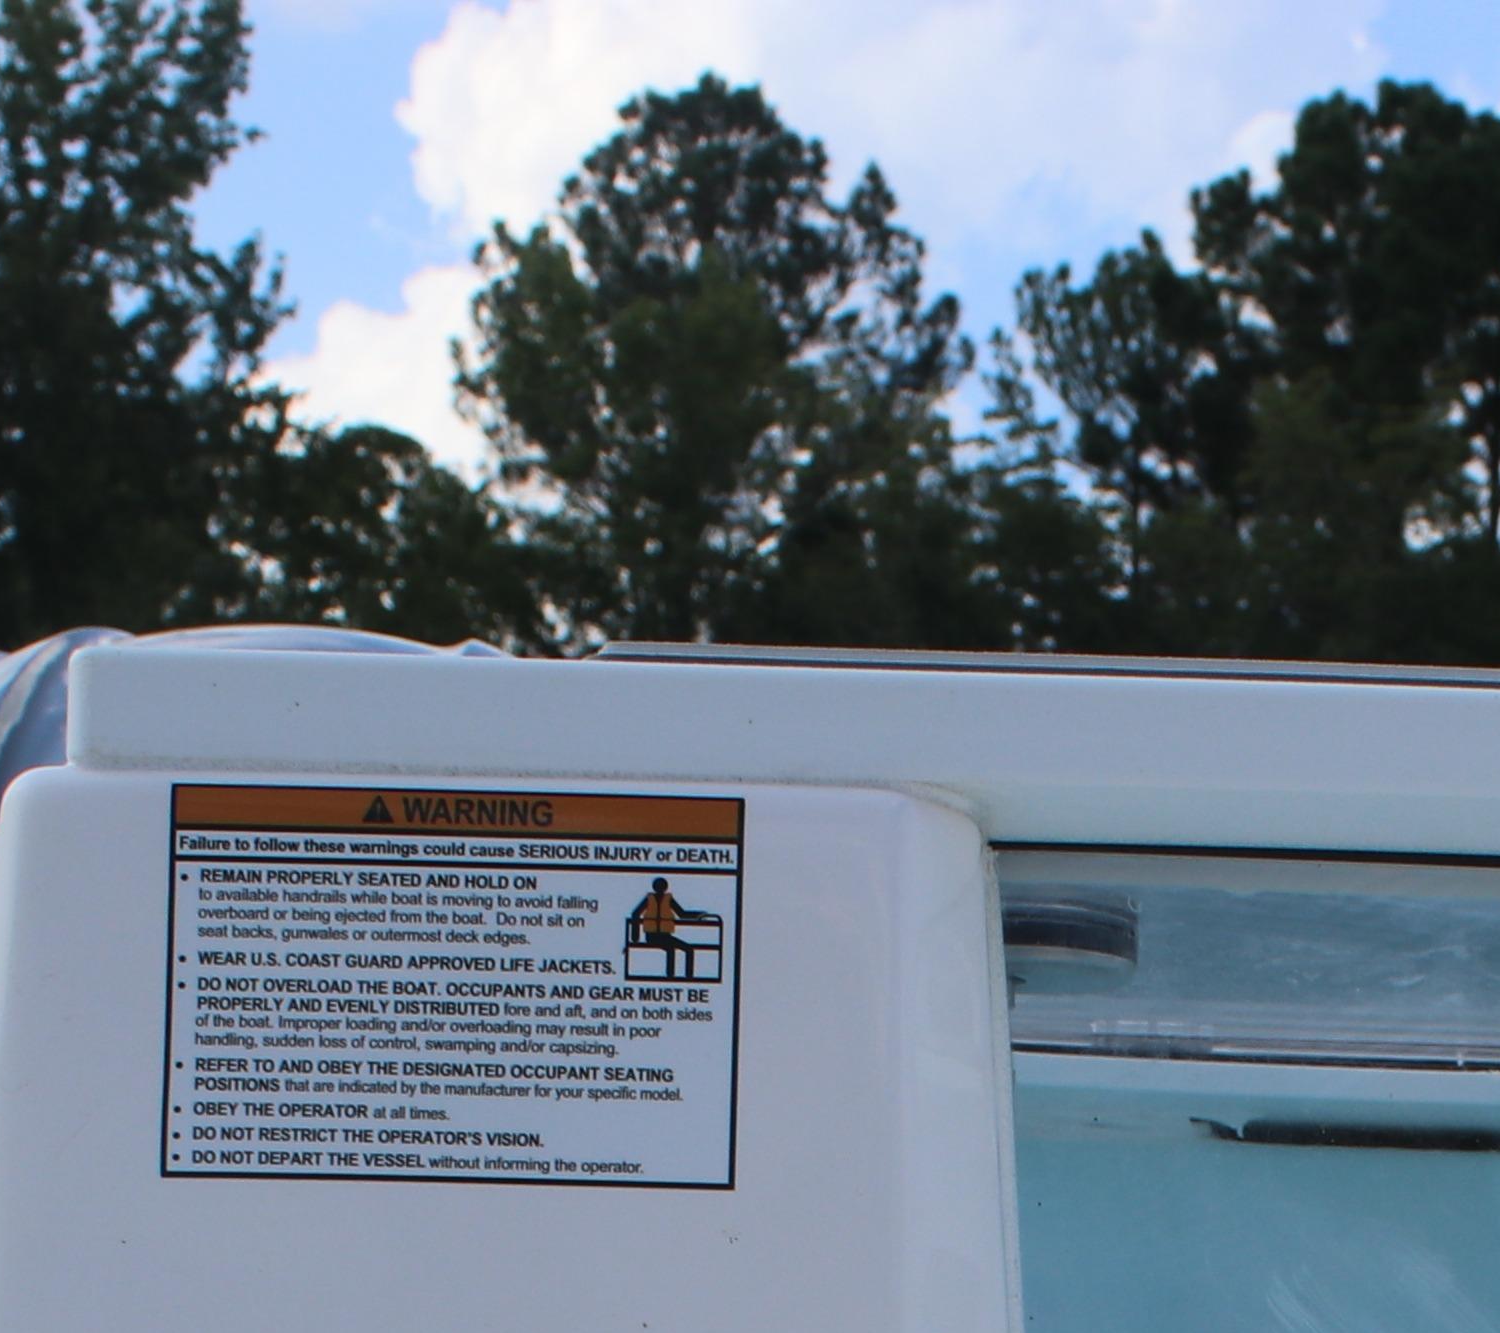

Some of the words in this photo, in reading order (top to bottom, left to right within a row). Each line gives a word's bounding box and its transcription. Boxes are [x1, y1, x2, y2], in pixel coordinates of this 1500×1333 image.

[401, 796, 553, 828] WARNING
[178, 835, 231, 851] Failure
[234, 837, 250, 851] to
[253, 836, 300, 852] follow
[303, 838, 346, 853] these
[348, 840, 419, 858] warnings
[422, 842, 466, 856] could
[469, 845, 515, 858] cause
[518, 843, 590, 860] SERIOUS
[593, 845, 652, 861] INJURY
[655, 850, 673, 862] or
[675, 847, 734, 864] DEATH.
[199, 868, 262, 884] REMAIN
[266, 869, 354, 886] PROPERLY
[357, 871, 422, 887] SEATED
[425, 873, 460, 889] AND
[464, 874, 509, 890] HOLD
[512, 875, 537, 890] ON
[198, 887, 213, 901] to
[215, 887, 279, 902] available
[282, 888, 347, 904] handrails
[350, 890, 388, 905] while
[390, 890, 423, 905] boat
[425, 891, 438, 906] is
[441, 893, 494, 910] moving
[496, 893, 511, 908] to
[514, 894, 553, 909] avoid
[556, 895, 599, 913] falling
[197, 905, 270, 920] overboard
[272, 909, 288, 921] or
[291, 907, 331, 925] being
[334, 908, 386, 925] ejected
[389, 908, 422, 924] from
[424, 909, 449, 925] the
[451, 910, 487, 925] boat.
[495, 911, 517, 926] Do
[520, 913, 543, 927] not
[546, 913, 563, 927] sit
[566, 916, 585, 928] on
[197, 950, 247, 966] WEAR
[250, 951, 281, 967] U.S.
[285, 952, 341, 968] COAST
[344, 953, 403, 969] GUARD
[406, 955, 496, 971] APPROVED
[499, 957, 534, 973] LIFE
[537, 958, 616, 975] JACKETS.
[197, 976, 222, 991] DO
[225, 977, 259, 992] NOT
[262, 977, 353, 994] OVERLOAD
[356, 979, 388, 995] THE
[392, 980, 441, 996] BOAT.
[445, 981, 546, 999] OCCUPANTS
[549, 984, 585, 1000] AND
[588, 985, 634, 1001] GEAR
[638, 987, 684, 1002] MUST
[687, 988, 709, 1003] BE
[196, 995, 284, 1012] PROPERLY
[287, 997, 322, 1013] AND
[325, 998, 390, 1014] EVENLY
[393, 999, 500, 1017] DISTRIBUTED
[503, 1001, 531, 1017] fore
[534, 1003, 561, 1017] and
[564, 1003, 586, 1020] aft,
[590, 1005, 617, 1019] and
[620, 1008, 638, 1019] on
[641, 1005, 673, 1020] both
[676, 1007, 713, 1022] sides
[194, 1031, 258, 1050] handling,
[262, 1033, 315, 1048] sudden
[318, 1034, 348, 1049] loss
[350, 1034, 366, 1049] of
[368, 1035, 421, 1052] control,
[424, 1037, 496, 1055] swamping
[499, 1038, 546, 1053] and/or
[548, 1040, 619, 1058] capsizing.
[195, 1057, 248, 1072] REFER
[252, 1058, 275, 1073] TO
[278, 1059, 314, 1074] AND
[316, 1059, 363, 1075] OBEY
[366, 1060, 398, 1076] THE
[402, 1061, 506, 1078] DESIGNATED
[509, 1063, 600, 1081] OCCUPANT
[603, 1066, 674, 1083] SEATING
[192, 1101, 239, 1116] OBEY
[241, 1101, 275, 1117] THE
[277, 1102, 368, 1119] OPERATOR
[372, 1106, 387, 1119] at
[389, 1105, 406, 1119] all
[409, 1106, 450, 1121] times.
[192, 1125, 217, 1140] DO
[220, 1126, 255, 1141] NOT
[258, 1126, 339, 1142] RESTRICT
[341, 1128, 374, 1143] THE
[377, 1128, 482, 1146] OPERATOR'S
[485, 1132, 544, 1148] VISION.
[191, 1149, 217, 1164] DO
[219, 1149, 254, 1165] NOT
[257, 1150, 324, 1166] DEPART
[326, 1151, 359, 1167] THE
[362, 1152, 426, 1168] VESSEL
[428, 1155, 480, 1169] without
[483, 1156, 551, 1174] informing
[554, 1158, 577, 1172] the
[580, 1160, 643, 1175] operator.
